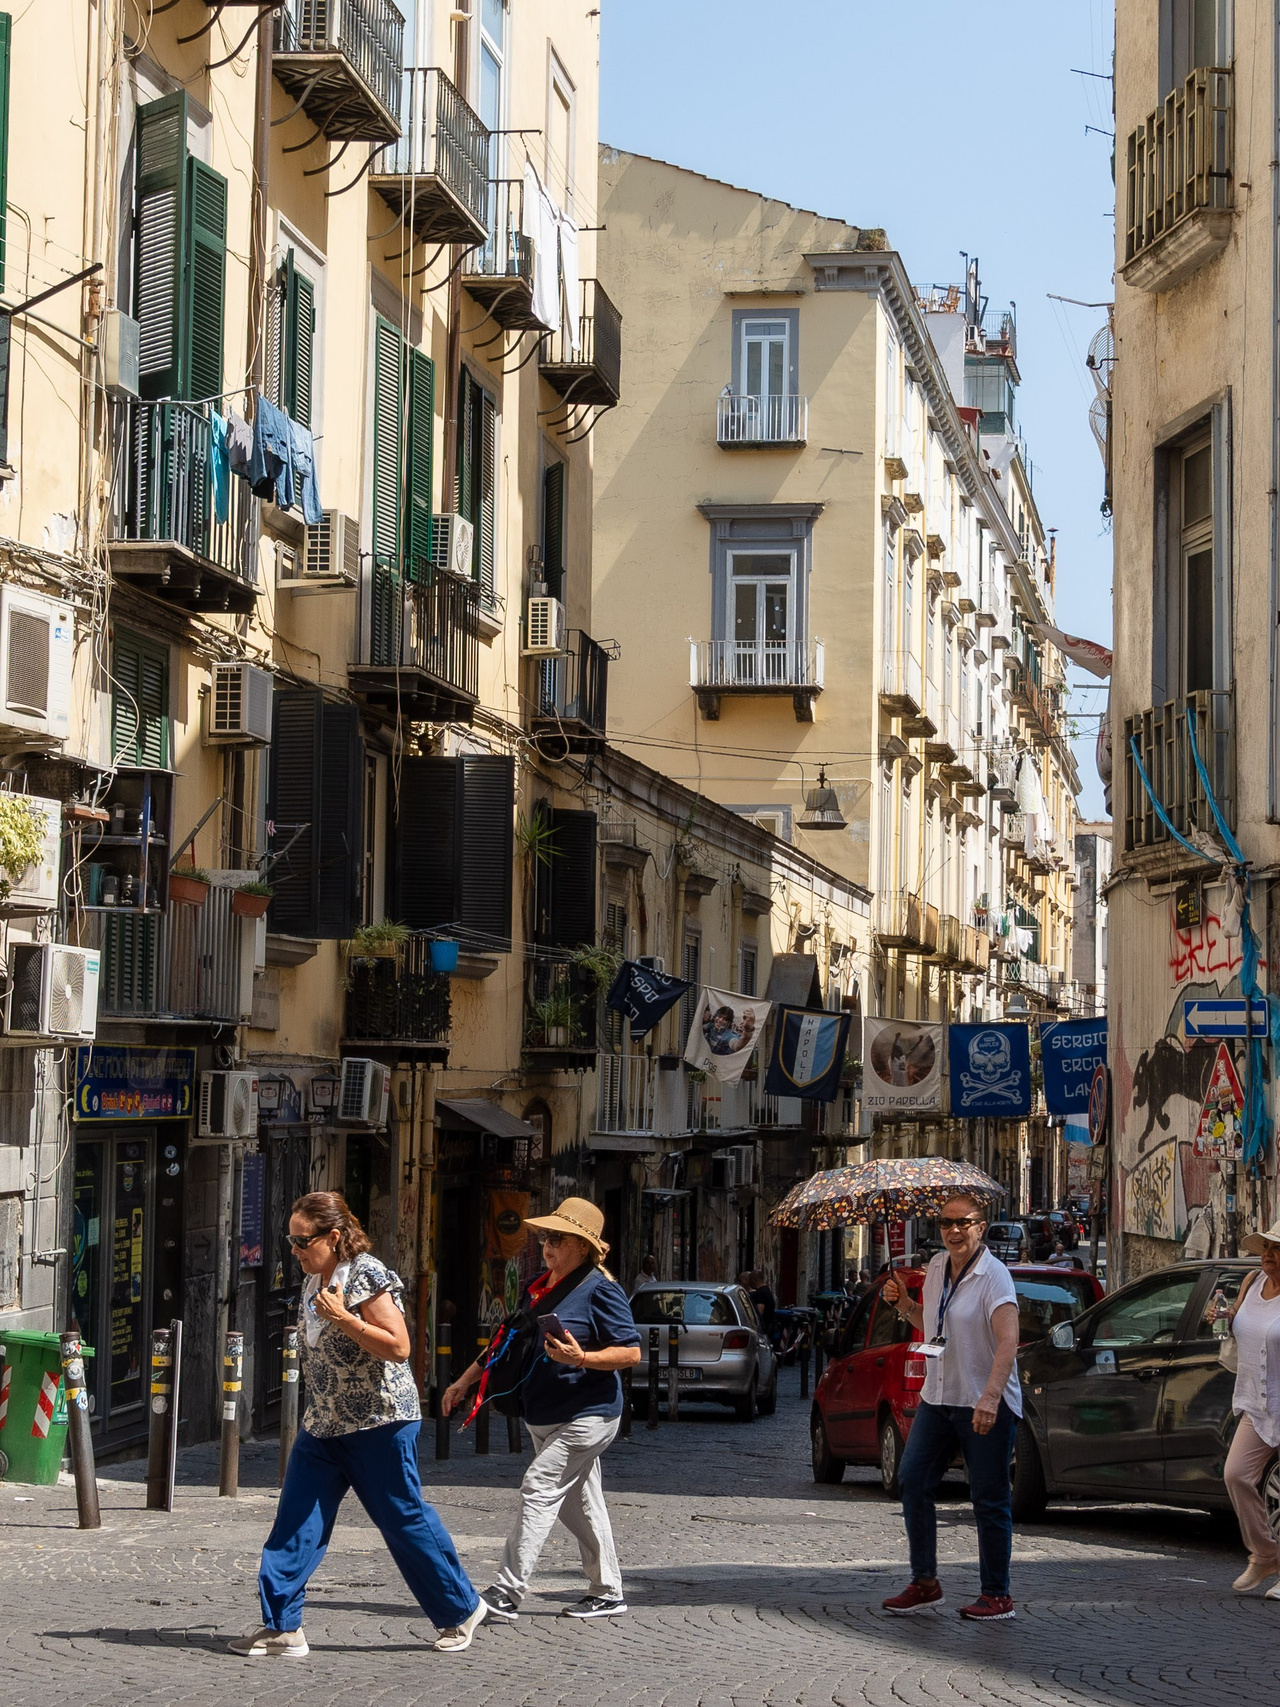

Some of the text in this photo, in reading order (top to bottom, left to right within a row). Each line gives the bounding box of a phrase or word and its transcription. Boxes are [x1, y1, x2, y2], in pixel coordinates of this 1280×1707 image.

[799, 1018, 815, 1080] NAPOLI
[1052, 1031, 1108, 1049] SERGIO
[868, 1096, 936, 1106] ZIO PADELLA
